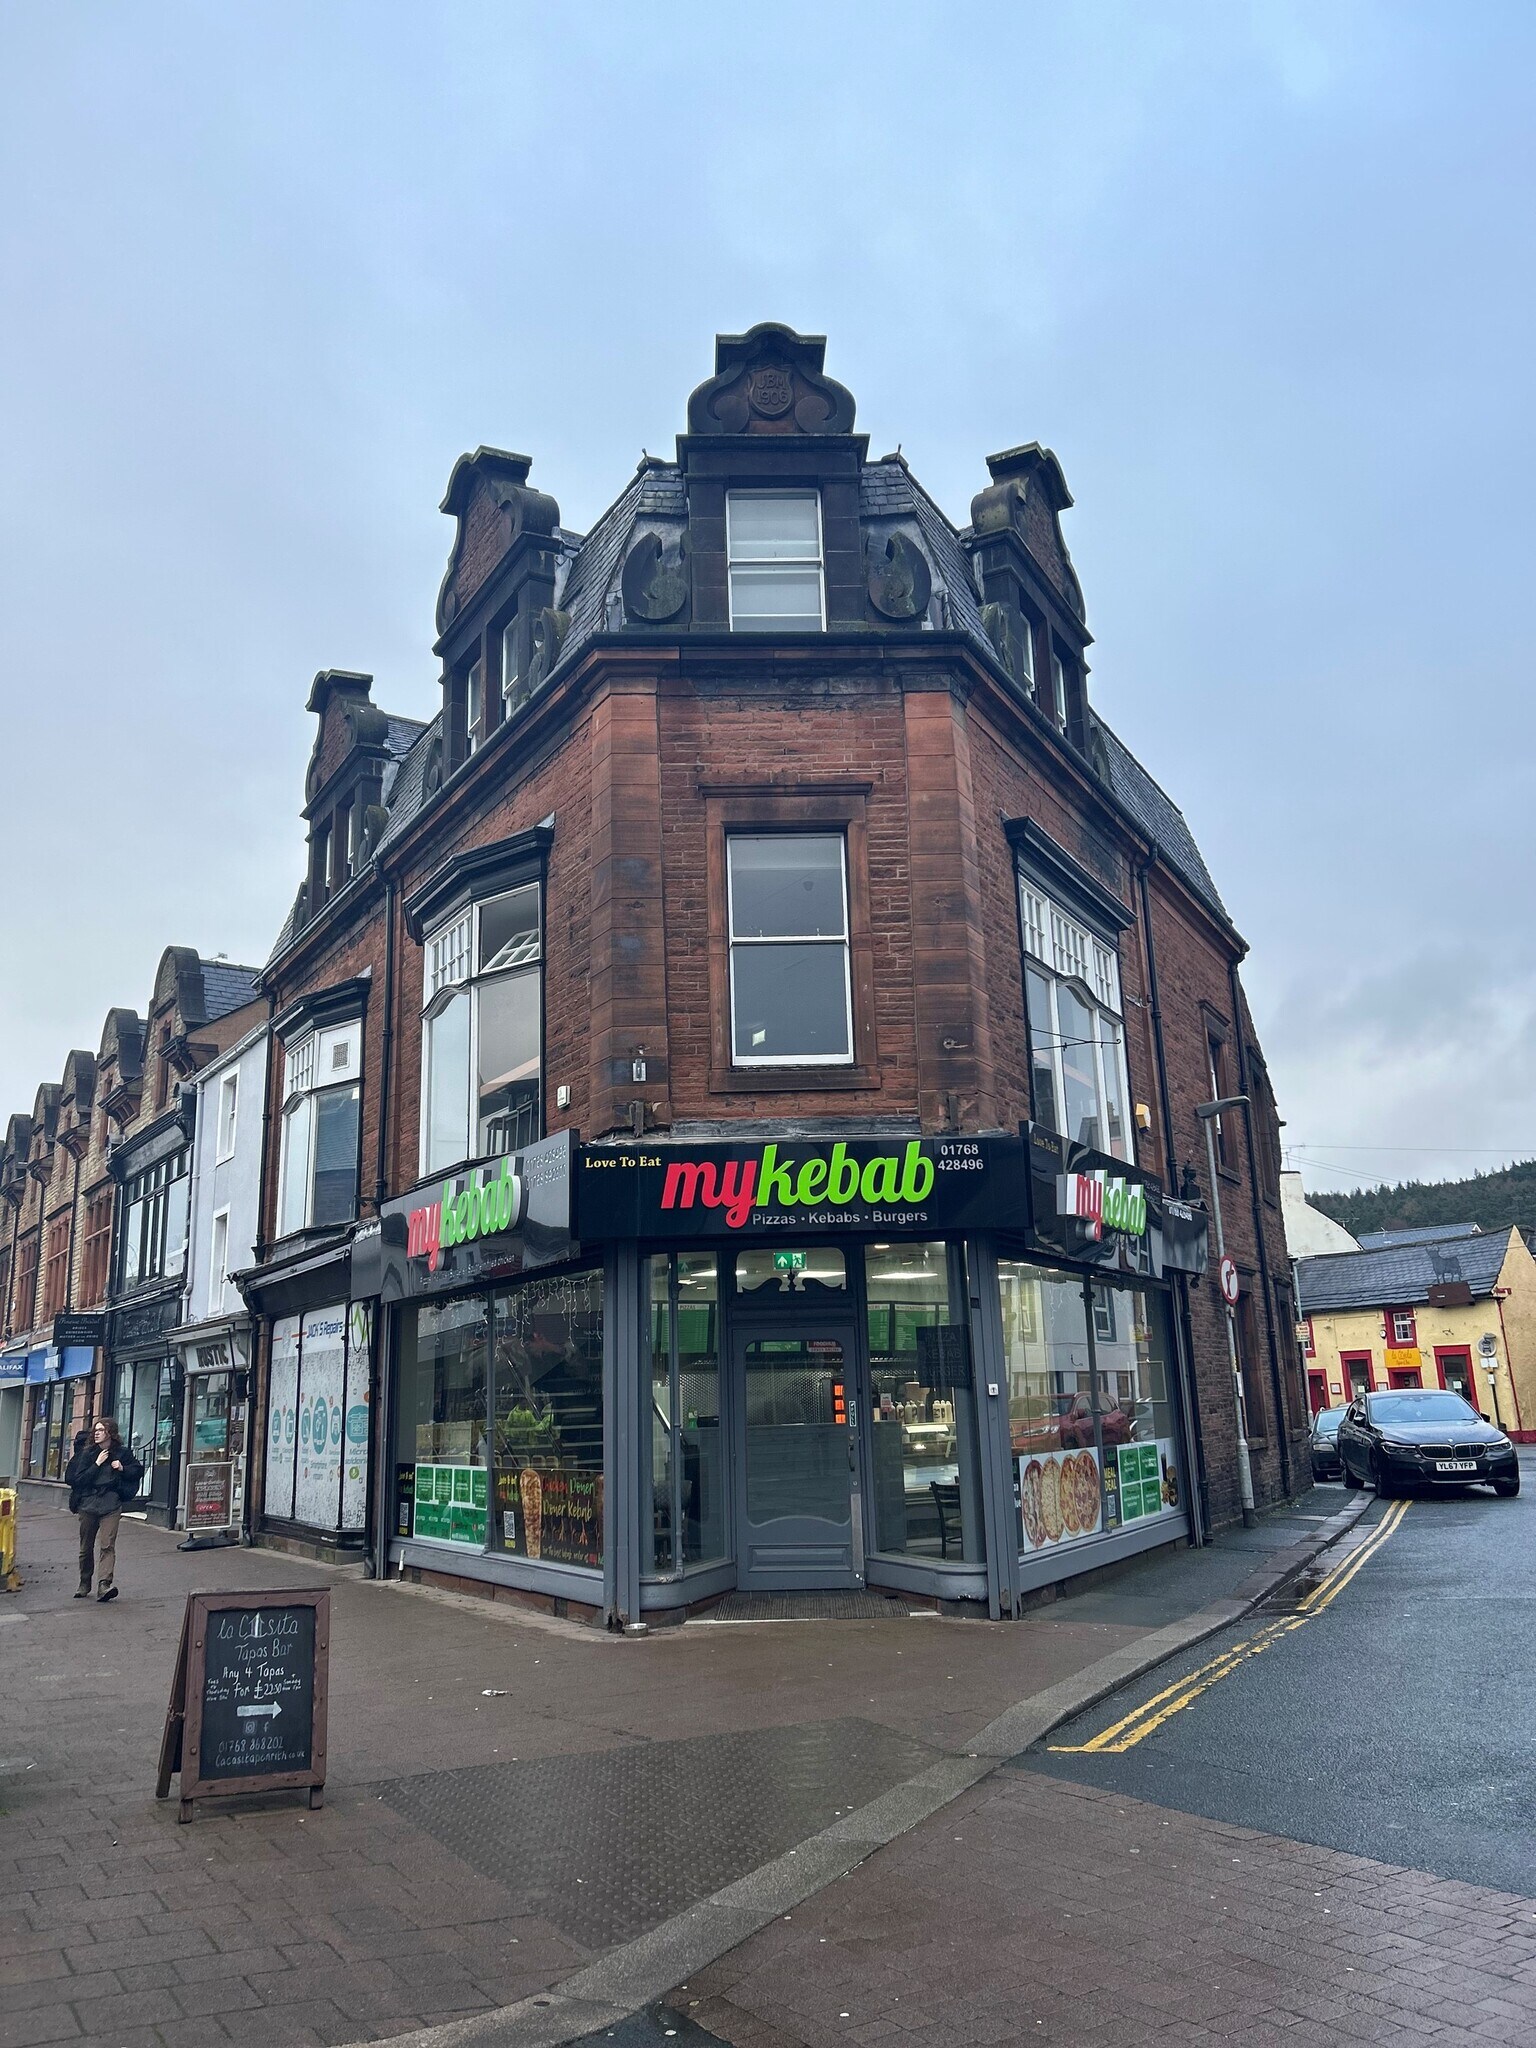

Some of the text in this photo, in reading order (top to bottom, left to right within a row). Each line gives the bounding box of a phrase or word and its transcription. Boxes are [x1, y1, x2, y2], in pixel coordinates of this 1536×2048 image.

[757, 390, 788, 405] 1906
[940, 1144, 979, 1156] 01768
[585, 1156, 662, 1168] Love To Eat
[937, 1159, 984, 1171] 428496
[752, 1210, 928, 1226] Pizzas Kebabs Burgers
[323, 1318, 344, 1338] Repairs
[196, 1343, 229, 1368] RUSTIC
[1104, 1467, 1117, 1479] MEAL
[1439, 1462, 1458, 1470] YL67
[1105, 1478, 1118, 1492] DEAL
[234, 1637, 293, 1667] Tapas Bar
[222, 1662, 285, 1685] Any 4 Tapas
[218, 1736, 284, 1753] 01768 868202
